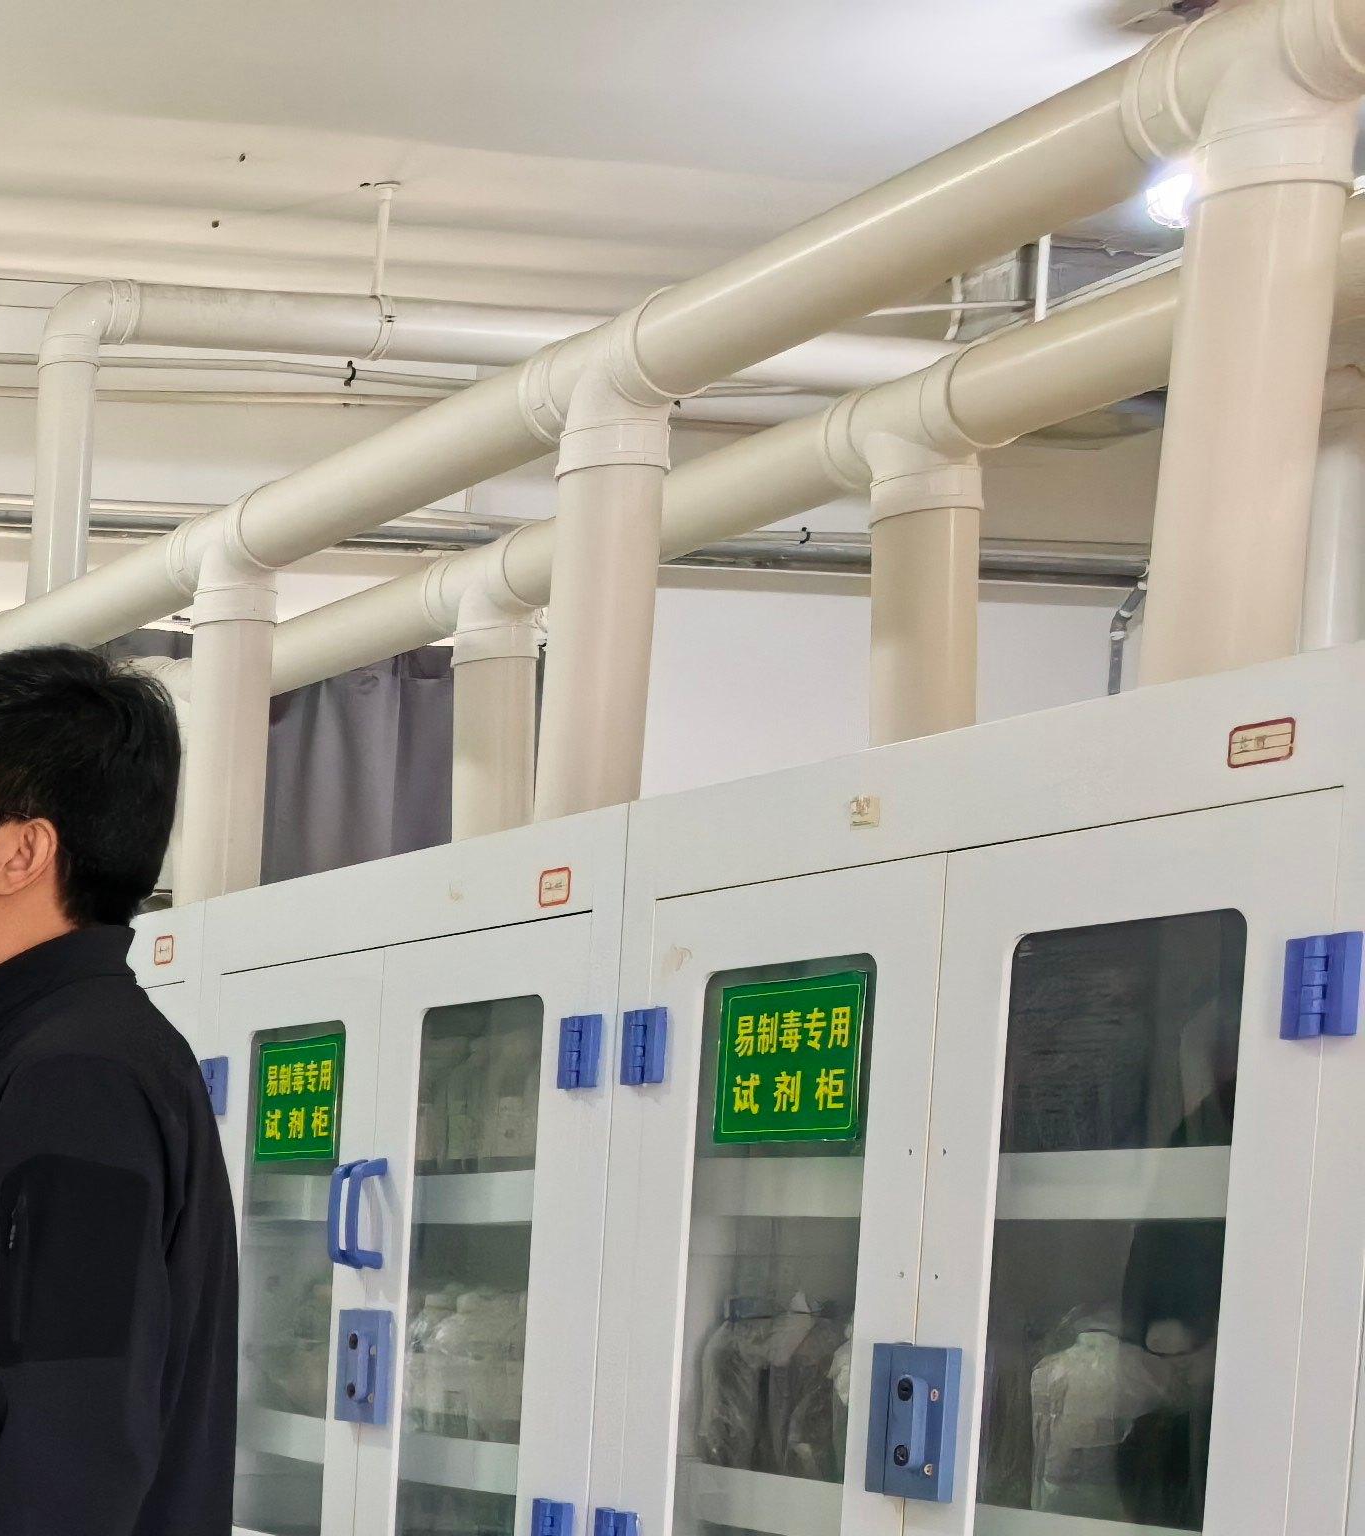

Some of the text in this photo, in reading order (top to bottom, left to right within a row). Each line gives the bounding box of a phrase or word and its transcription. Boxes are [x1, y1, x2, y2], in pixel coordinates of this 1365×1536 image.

[734, 1005, 852, 1058] 易制毒专用
[265, 1059, 334, 1097] 易制毒专用
[732, 1068, 846, 1115] 试剂柜
[264, 1106, 332, 1140] 试剂柜
